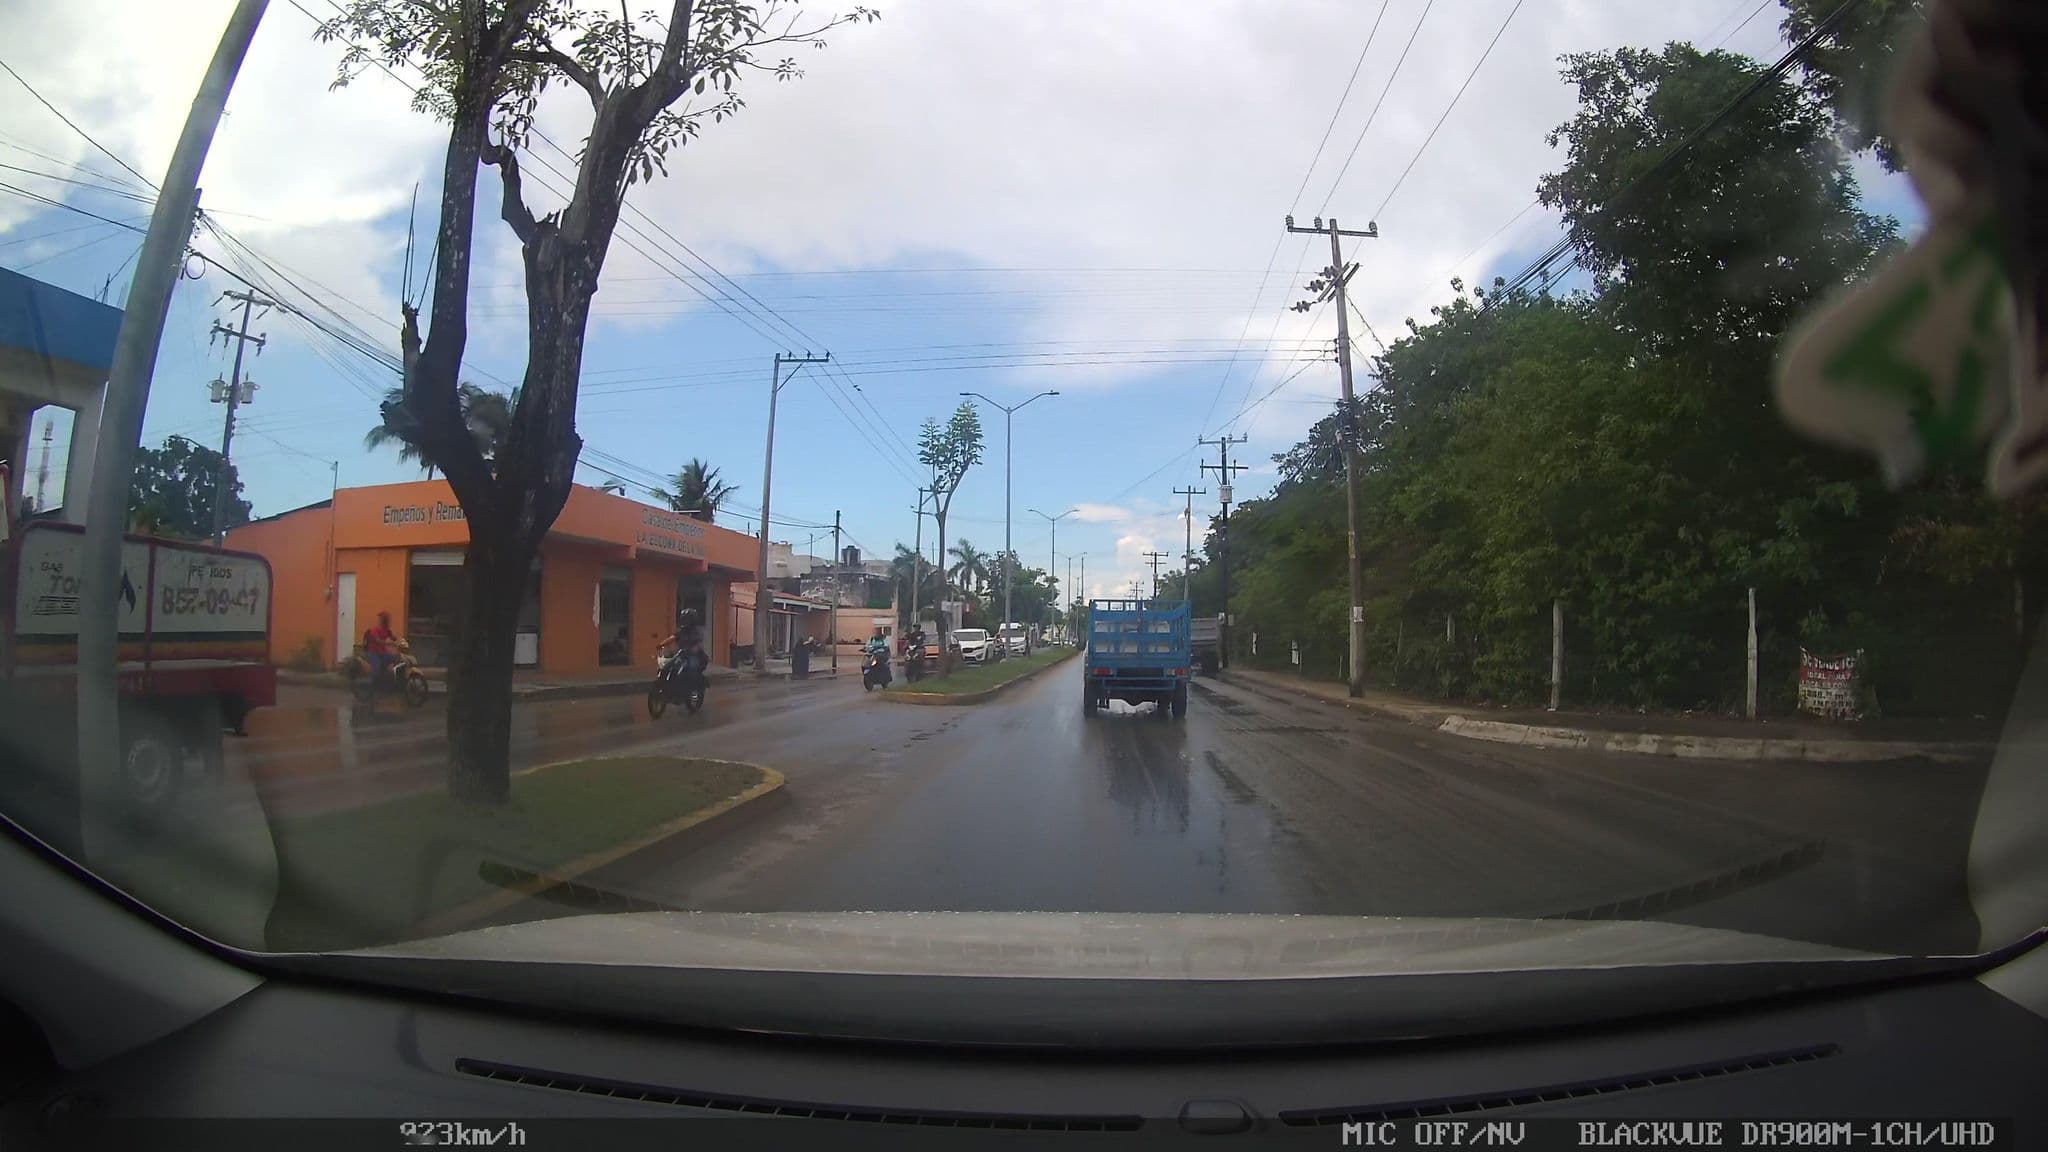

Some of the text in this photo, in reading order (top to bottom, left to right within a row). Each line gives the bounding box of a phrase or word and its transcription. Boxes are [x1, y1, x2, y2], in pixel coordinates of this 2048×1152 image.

[384, 505, 425, 526] Empeños
[427, 507, 434, 526] y
[41, 562, 64, 572] GAS
